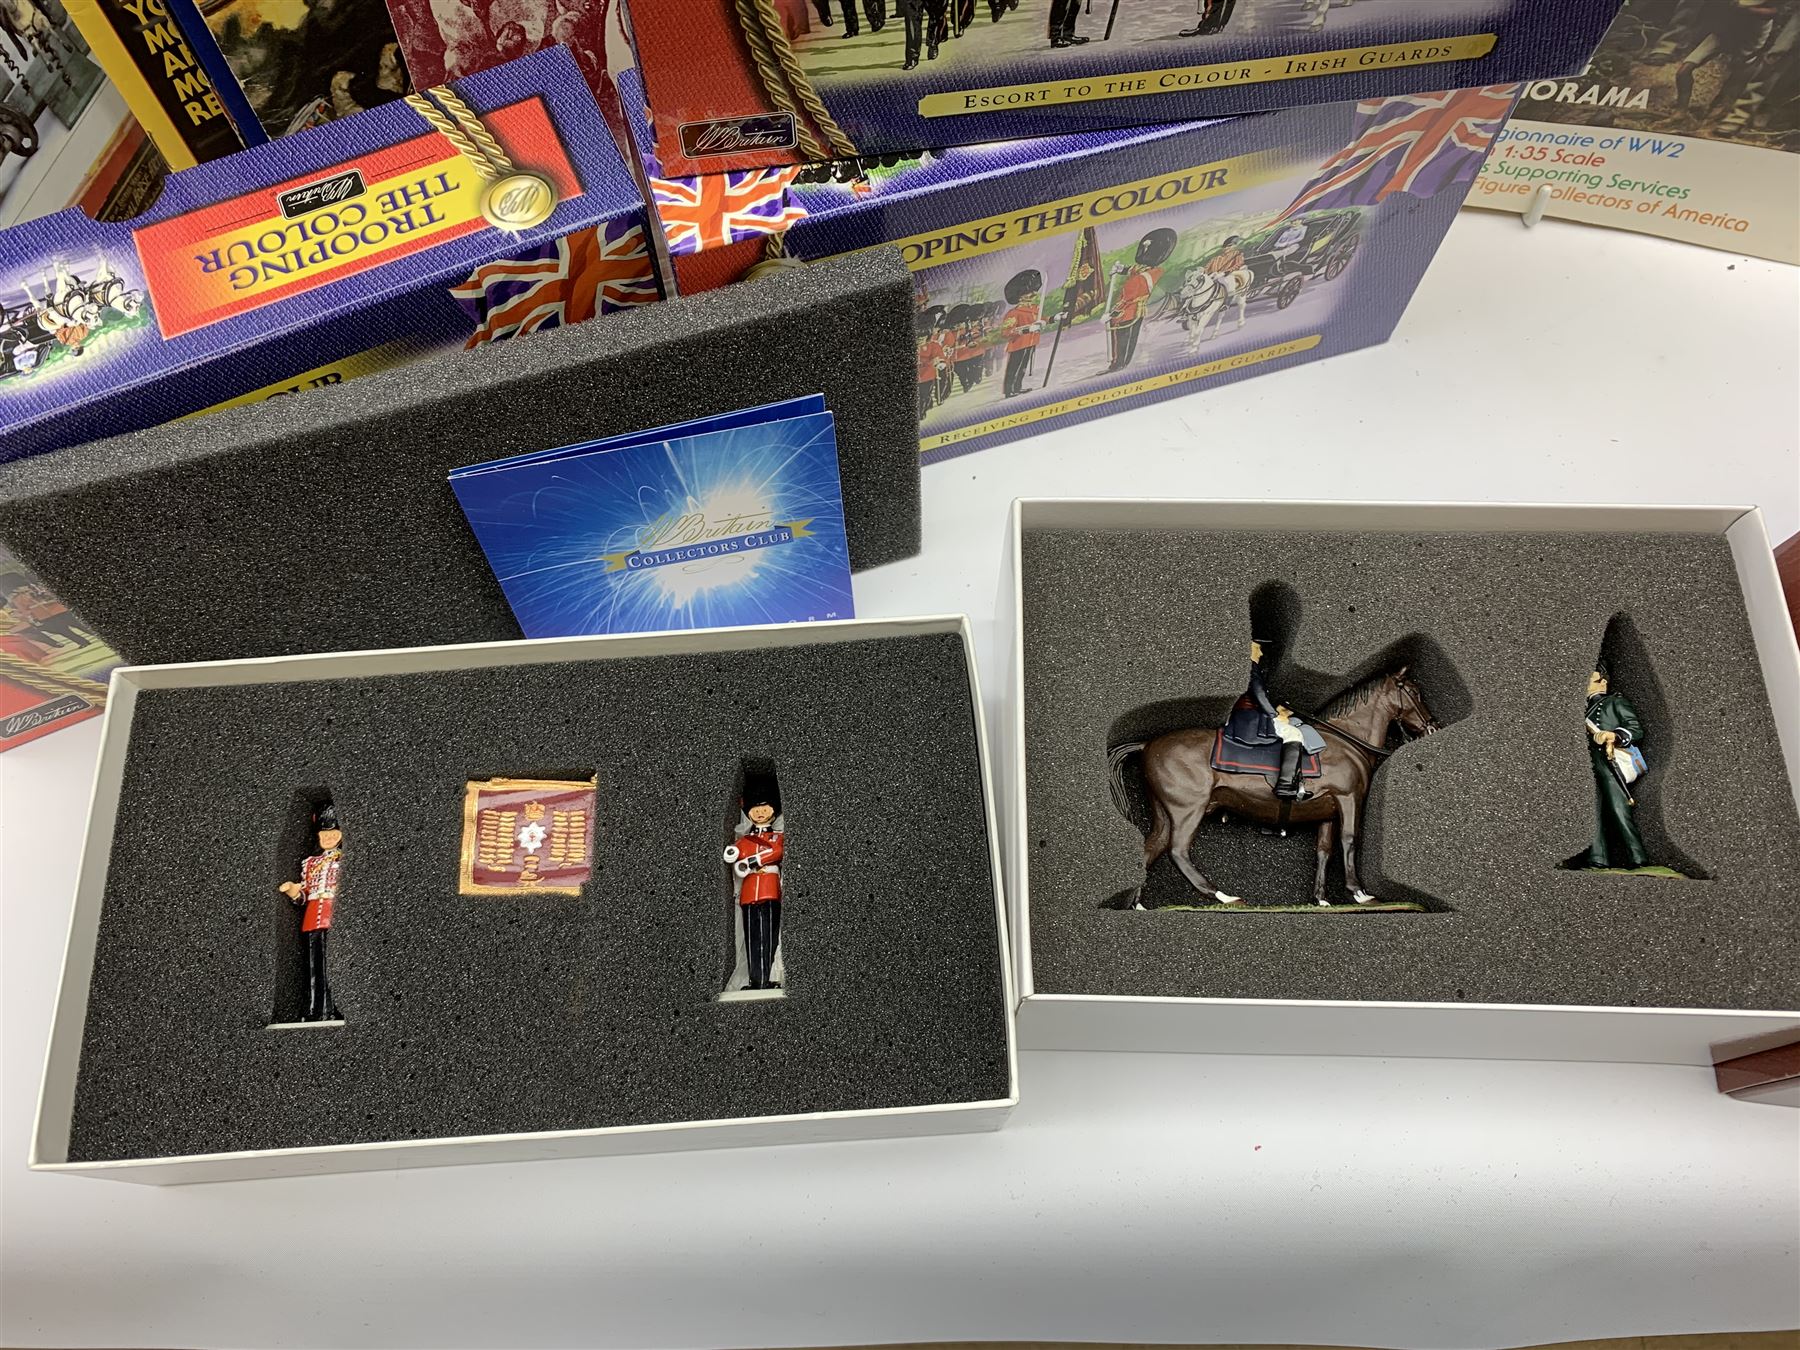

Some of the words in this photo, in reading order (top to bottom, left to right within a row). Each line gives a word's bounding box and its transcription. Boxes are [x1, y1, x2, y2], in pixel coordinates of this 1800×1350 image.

[963, 89, 1051, 109] ESCORT
[1063, 85, 1092, 98] TO
[1104, 79, 1147, 93] THE
[1159, 68, 1251, 88] COLOUR
[1285, 57, 1347, 74] IRISH
[1359, 45, 1453, 66] GUARDS
[1520, 80, 1651, 110] IORAMA
[1495, 127, 1594, 149] gionnaire
[1599, 136, 1626, 151] of
[1629, 137, 1686, 159] WW2
[1504, 145, 1549, 161] 1:35
[1550, 148, 1606, 168] Scale
[375, 171, 461, 215] THE
[1493, 160, 1604, 190] Supporting
[1606, 173, 1691, 200] Services
[900, 222, 1007, 265] OPING
[1014, 202, 1084, 236] THE
[1089, 167, 1229, 217] COLOUR
[1636, 200, 1664, 215] of
[1661, 203, 1750, 232] America
[193, 202, 368, 274] COLOUR
[229, 202, 446, 291] TROOPING
[939, 416, 1031, 445] RECEIVING
[1038, 404, 1069, 418] THE
[1077, 384, 1144, 407] COLOUR
[1168, 363, 1223, 384] WELSH
[1230, 344, 1297, 367] GUARDS
[628, 540, 740, 569] COLLECTORS
[744, 530, 791, 548] CLUB
